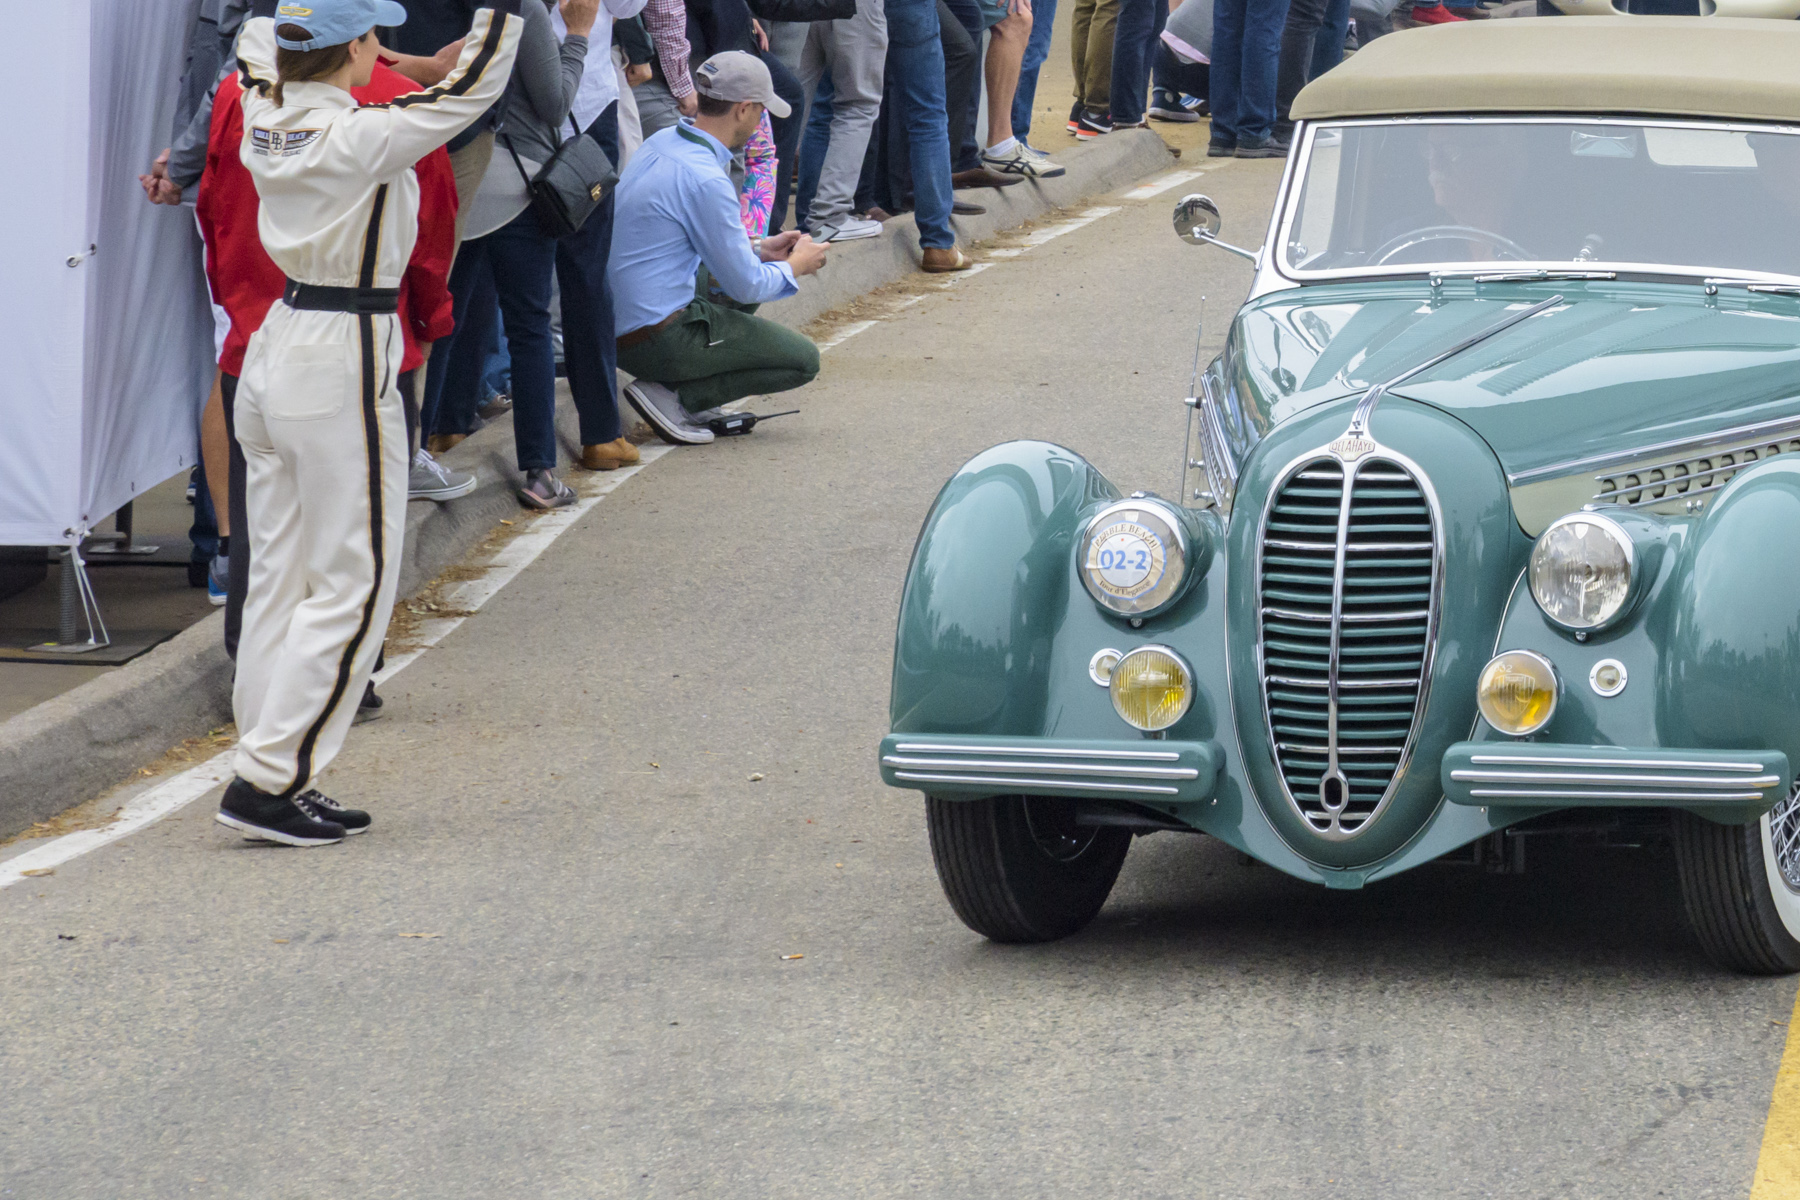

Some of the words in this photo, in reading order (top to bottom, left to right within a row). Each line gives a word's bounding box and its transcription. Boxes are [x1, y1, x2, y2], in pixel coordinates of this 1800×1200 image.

[1331, 440, 1373, 453] DELAHAYE
[1094, 523, 1127, 547] PEBBLE
[1128, 524, 1158, 549] BEACH
[1099, 580, 1114, 593] Tour
